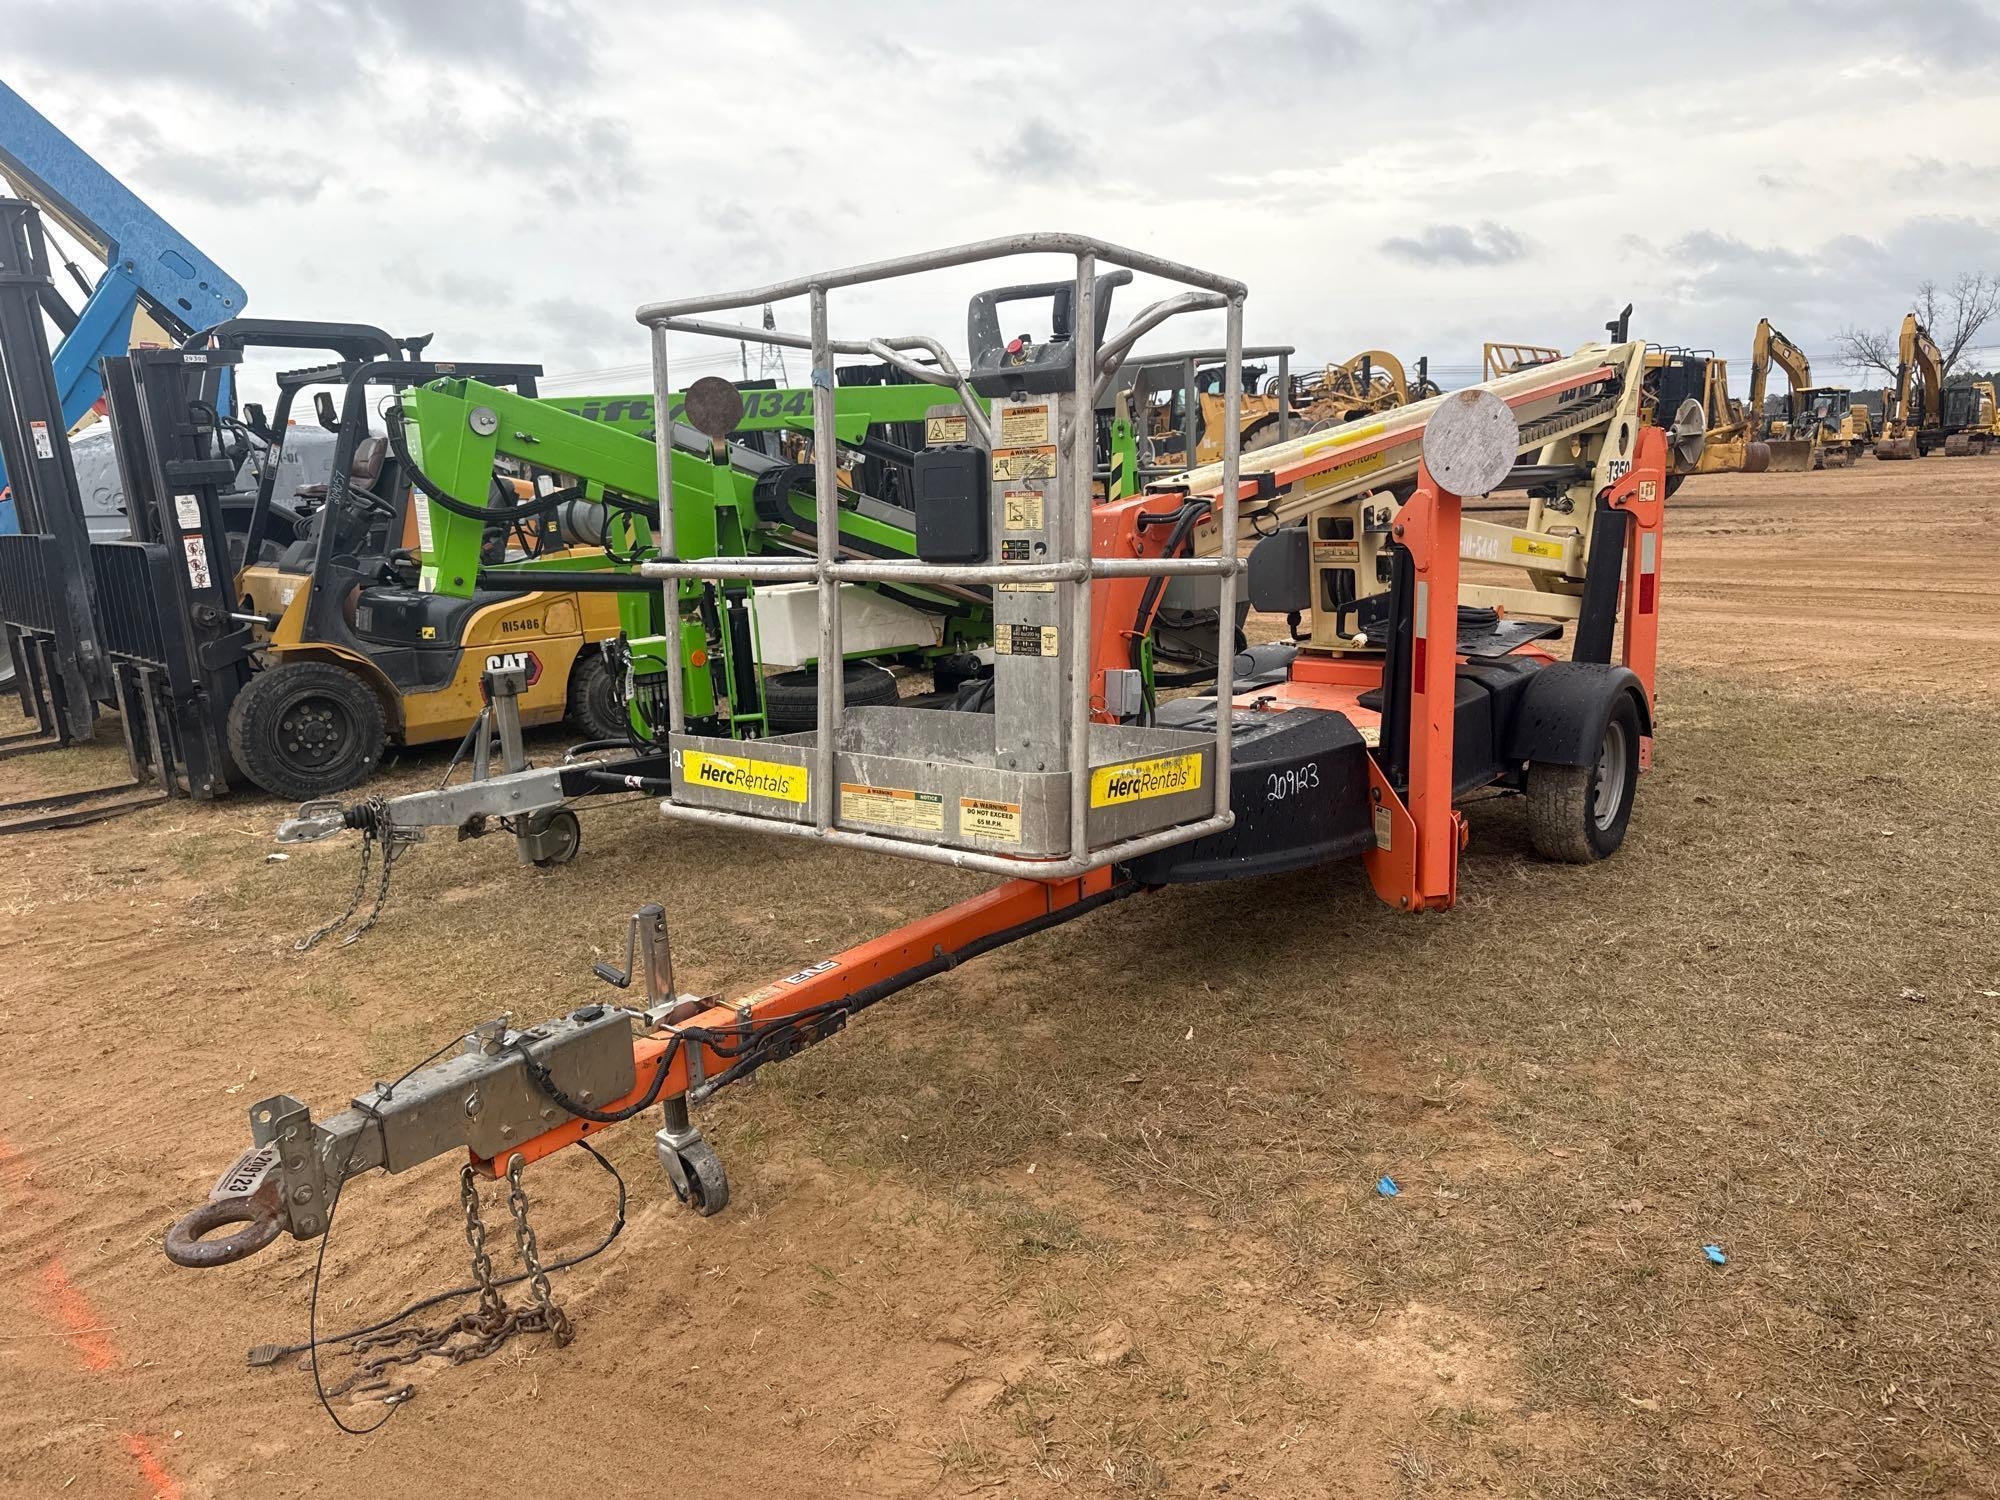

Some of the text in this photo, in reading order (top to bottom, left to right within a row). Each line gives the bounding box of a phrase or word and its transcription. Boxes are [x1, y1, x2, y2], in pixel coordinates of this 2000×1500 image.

[486, 653, 529, 671] CAT
[1267, 762, 1319, 801] 209123
[980, 802, 1008, 811] WARNING
[990, 811, 1014, 820] EXCEED
[228, 1156, 273, 1192] 209123
